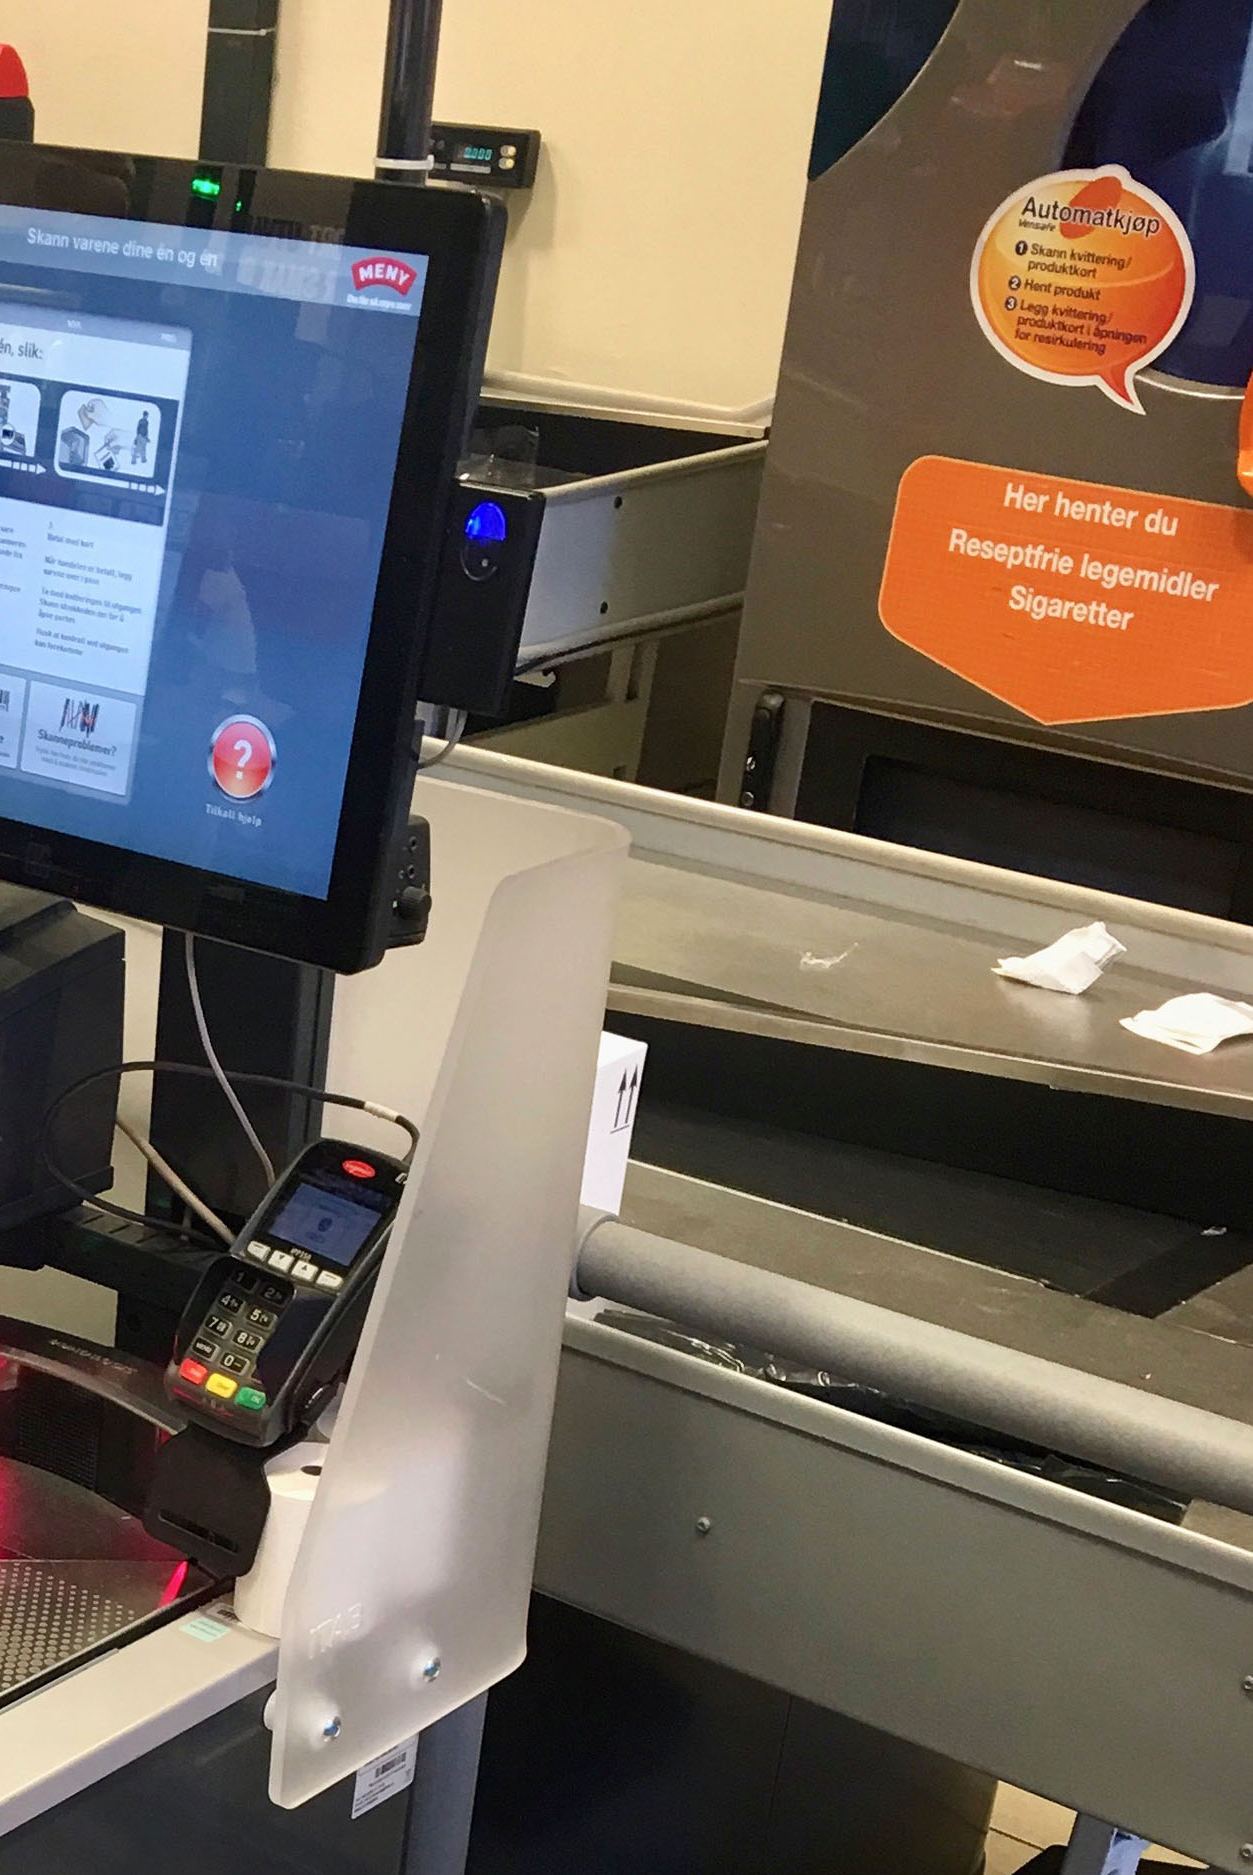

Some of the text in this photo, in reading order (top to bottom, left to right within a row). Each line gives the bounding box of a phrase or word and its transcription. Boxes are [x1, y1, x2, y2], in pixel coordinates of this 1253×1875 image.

[1021, 197, 1160, 237] Automatkjøp
[27, 227, 69, 249] Skann
[73, 236, 119, 255] varene
[123, 240, 153, 259] dine
[178, 250, 196, 268] og
[1030, 243, 1067, 260] Skann
[359, 263, 410, 286] MENY
[1028, 260, 1097, 279] produktkort
[1024, 279, 1051, 293] Hent
[1053, 283, 1101, 301] produkt
[1020, 299, 1049, 317] Legg
[1017, 315, 1084, 334] produktkort
[17, 339, 44, 360] slik:
[1034, 333, 1106, 355] resirkulering
[1003, 482, 1178, 537] Her henter du
[948, 528, 1219, 602] Reseptfrie legemidler
[1009, 585, 1134, 631] Sigaretter
[37, 728, 117, 757] Skanneproblemer?
[250, 1308, 262, 1322] 5
[208, 1316, 220, 1329] 7
[237, 1331, 248, 1345] 8
[223, 1354, 235, 1368] 0
